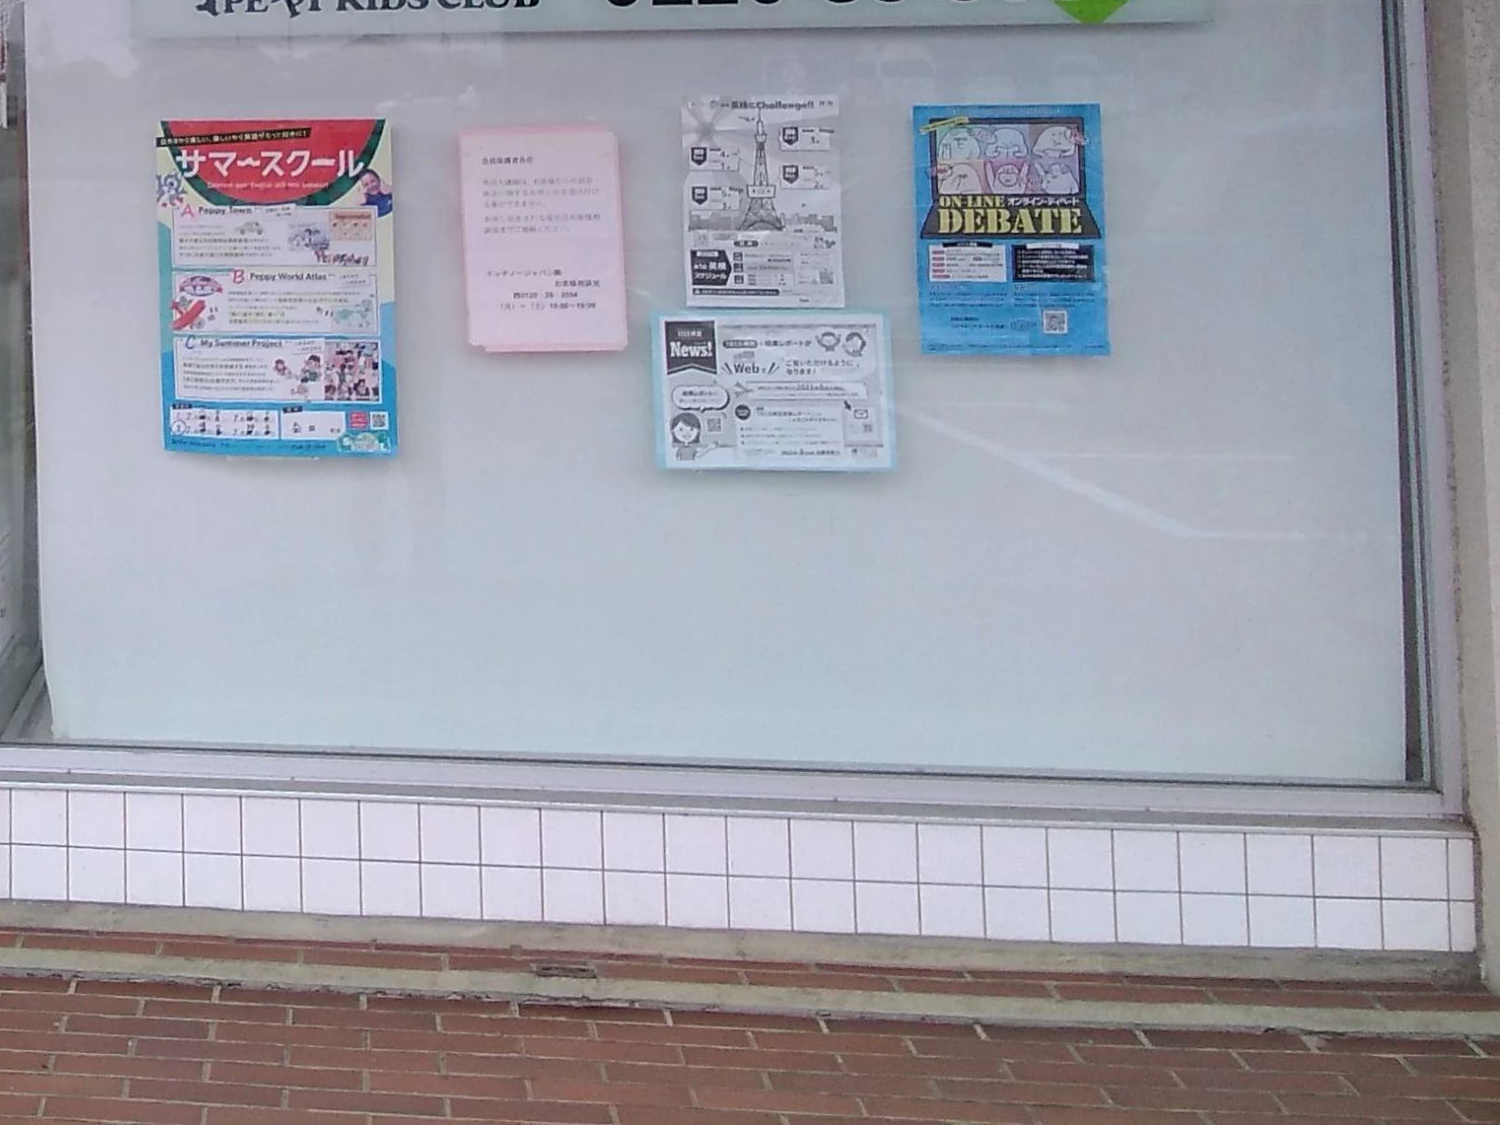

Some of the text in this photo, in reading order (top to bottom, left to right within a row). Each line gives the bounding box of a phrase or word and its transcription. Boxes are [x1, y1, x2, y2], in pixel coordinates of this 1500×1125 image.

[176, 149, 364, 178] サマースクール
[939, 196, 1005, 208] ON-LINE
[938, 208, 1082, 234] DEBATE
[232, 269, 245, 284] B
[250, 272, 276, 282] Peppy
[279, 272, 304, 280] World
[670, 341, 713, 358] News!
